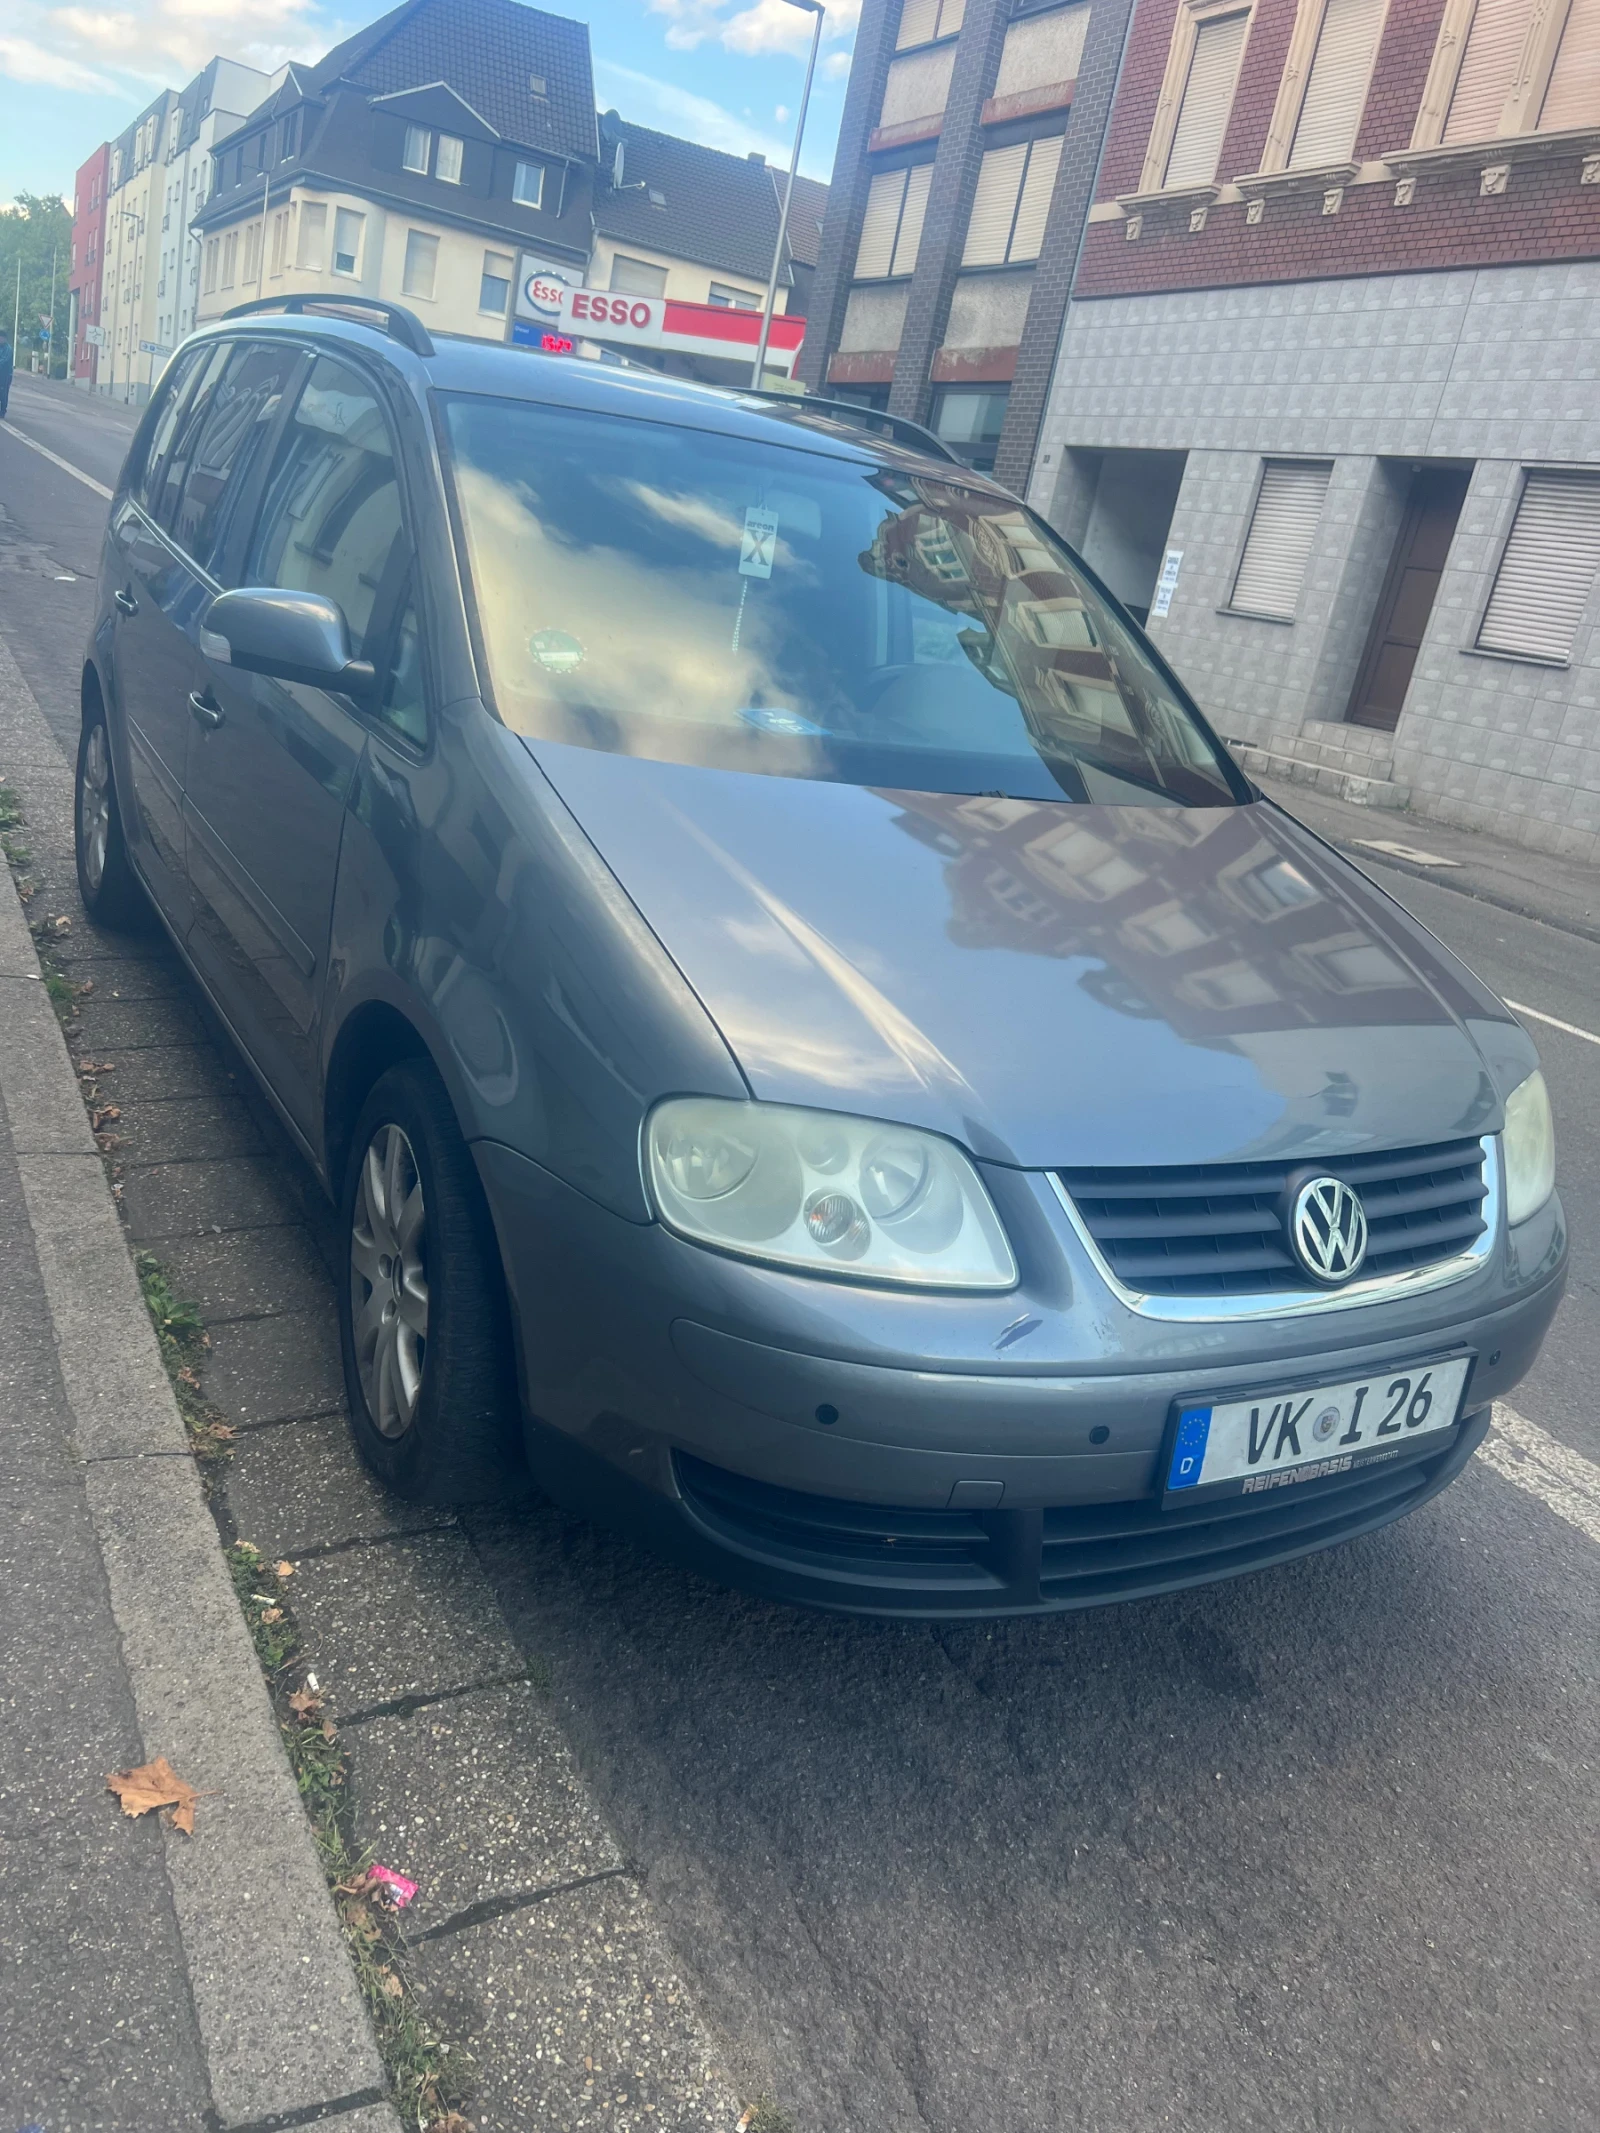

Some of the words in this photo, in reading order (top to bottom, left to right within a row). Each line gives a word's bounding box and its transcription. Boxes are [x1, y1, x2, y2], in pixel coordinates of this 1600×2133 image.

[571, 292, 652, 329] ESSO
[746, 520, 775, 532] areon
[742, 529, 775, 566] X
[1247, 1397, 1314, 1465] VK
[1339, 1386, 1370, 1446] I
[1376, 1372, 1433, 1437] 26
[1180, 1456, 1194, 1475] D
